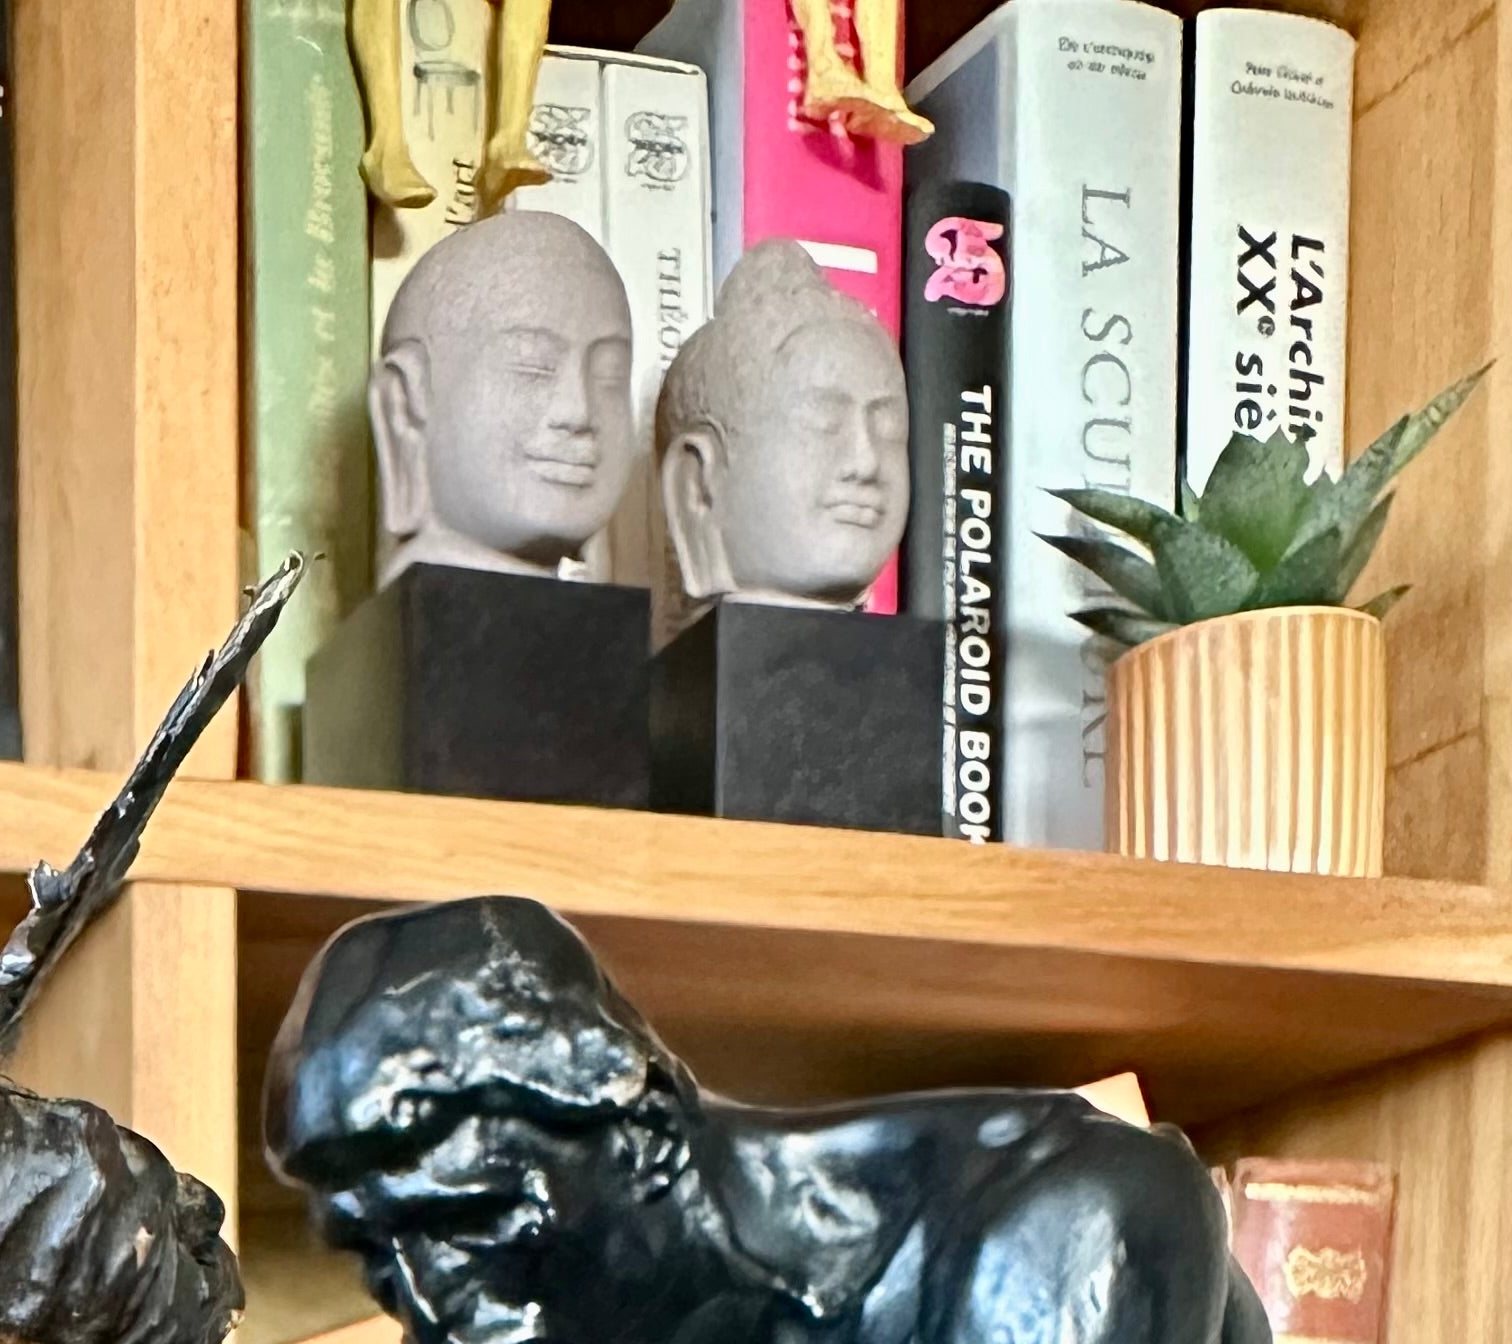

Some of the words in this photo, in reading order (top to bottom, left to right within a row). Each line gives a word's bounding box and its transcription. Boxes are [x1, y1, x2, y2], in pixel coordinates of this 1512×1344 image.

[1081, 183, 1132, 278] LA
[960, 384, 992, 474] THE
[959, 488, 992, 716] POLAROID
